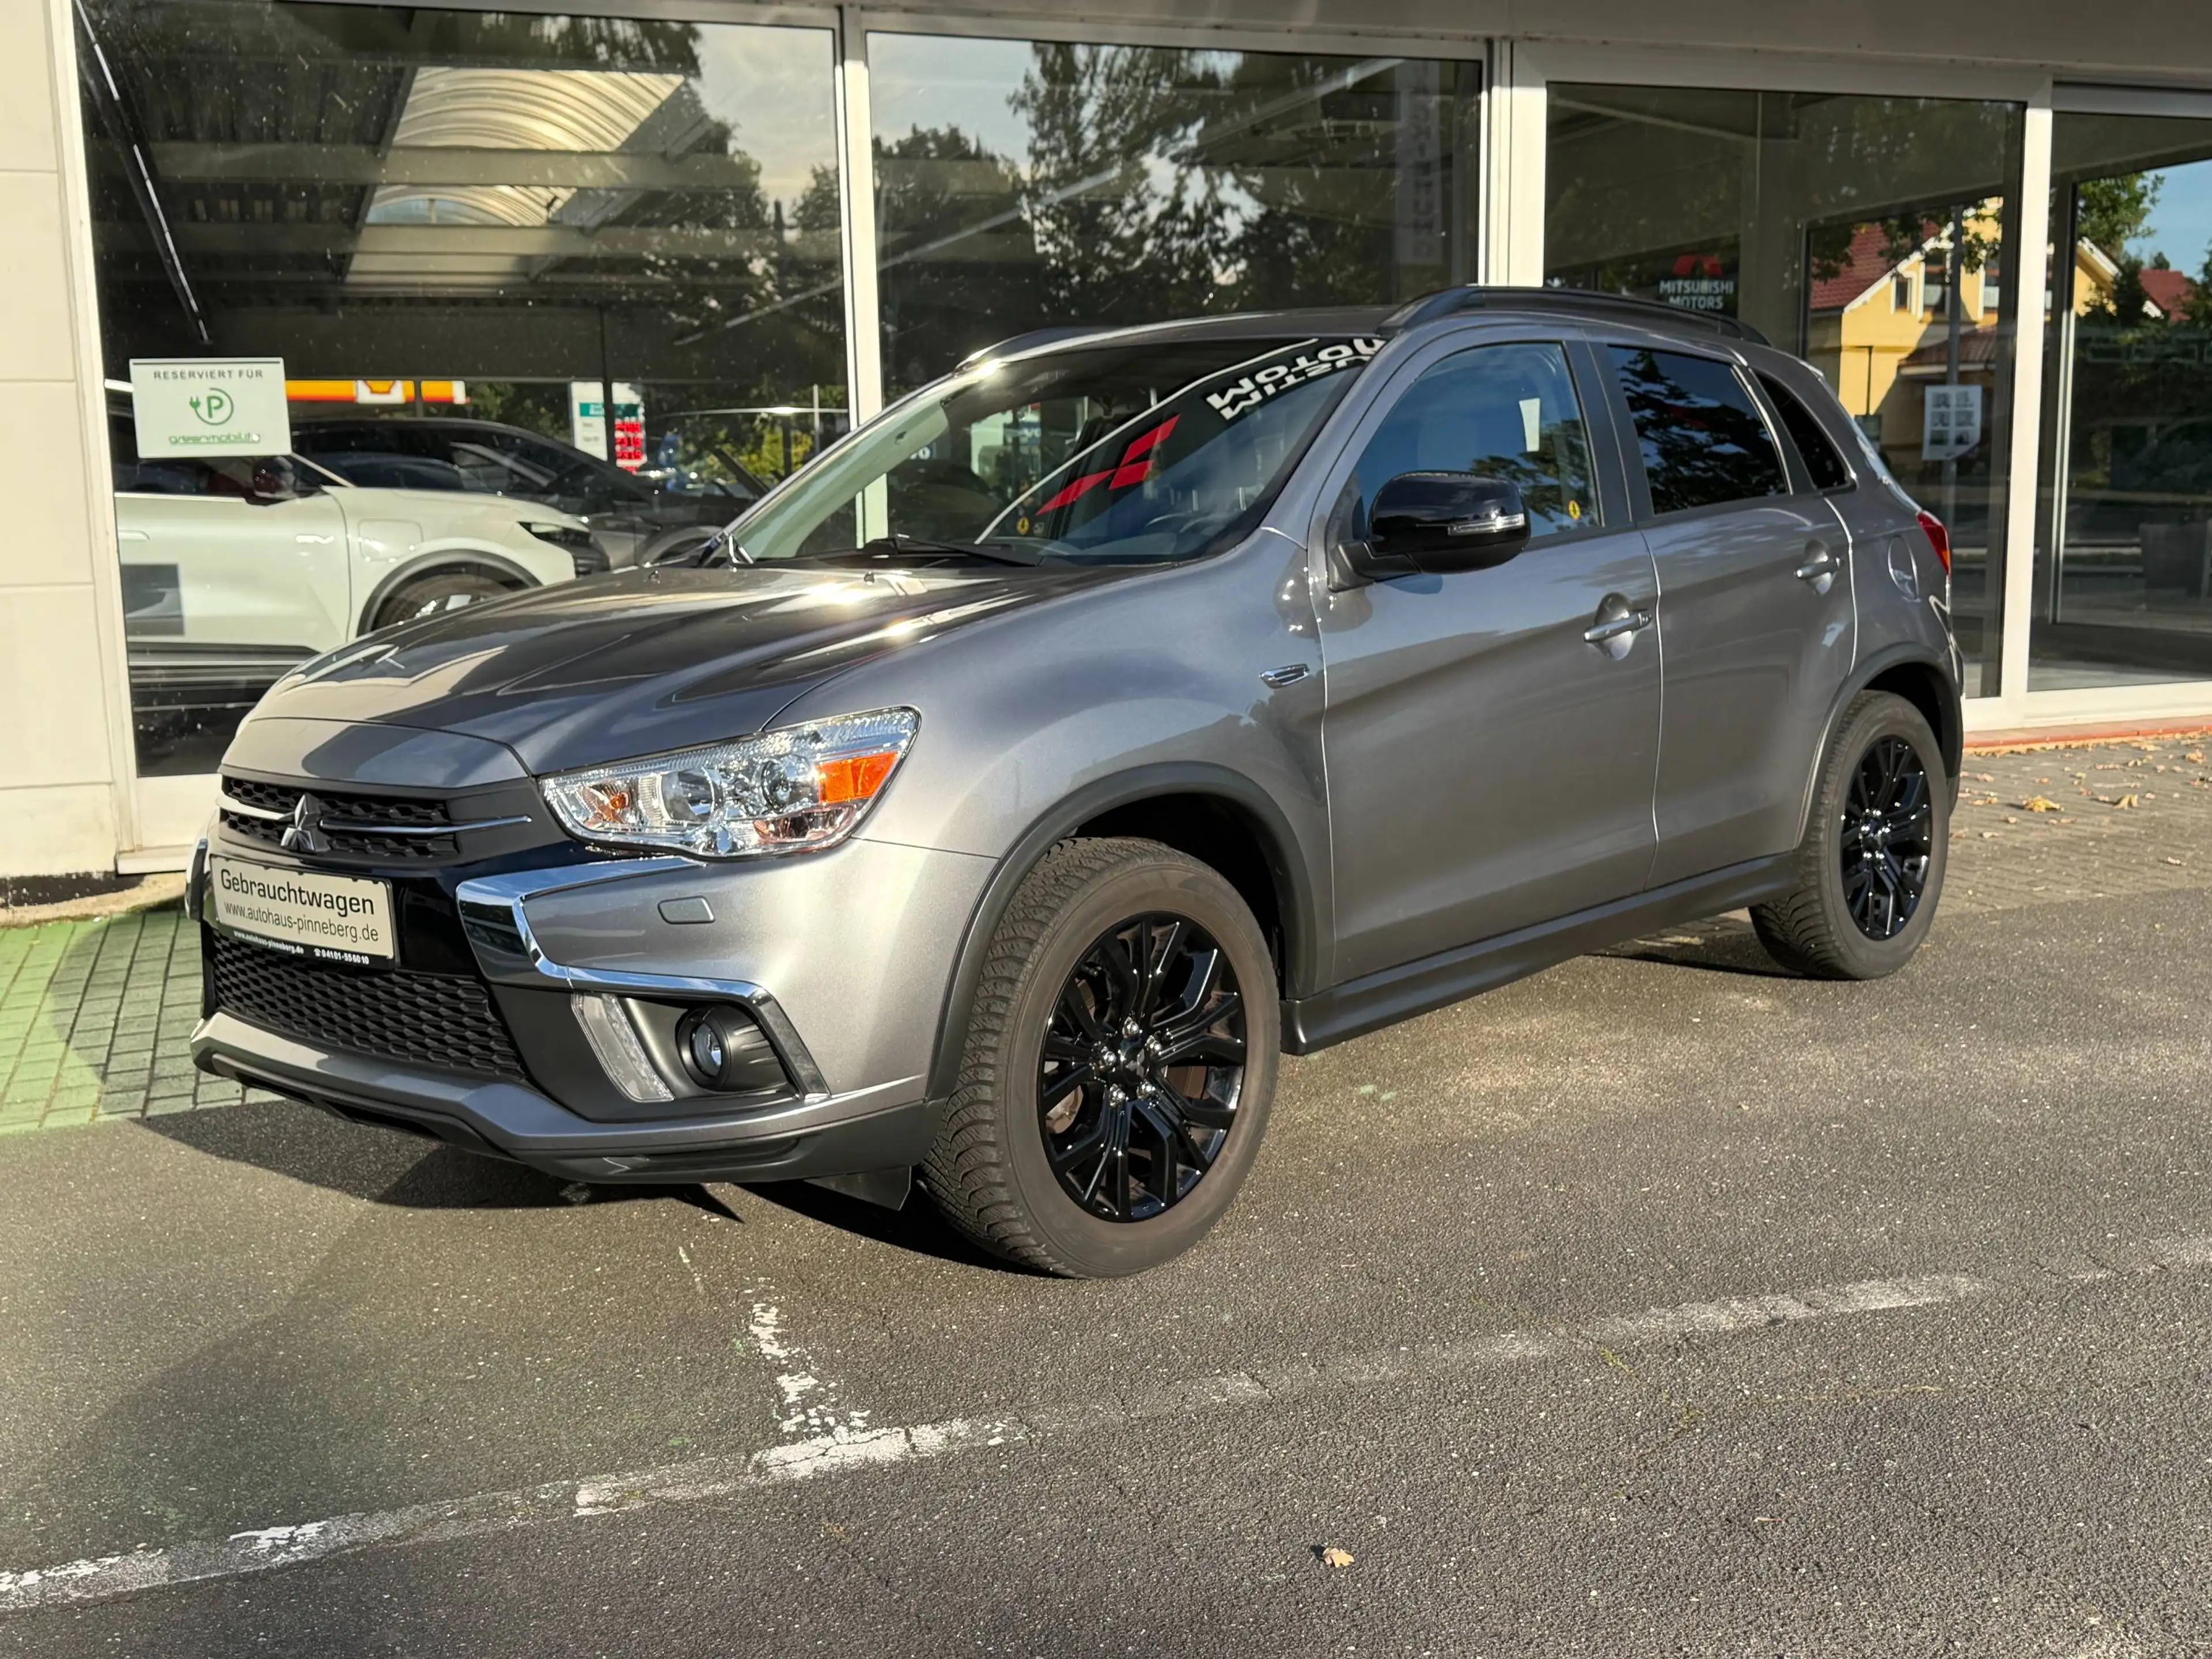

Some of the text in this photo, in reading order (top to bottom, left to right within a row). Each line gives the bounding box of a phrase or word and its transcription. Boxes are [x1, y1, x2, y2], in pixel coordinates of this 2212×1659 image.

[1660, 279, 1734, 294] MITSUBISHI
[1669, 296, 1724, 310] MOTORS
[153, 368, 263, 380] RESERVIERT FÜR
[221, 869, 375, 917] Gebrauchtwagen
[224, 902, 378, 944] www.autohaus-pinneberg.de
[233, 930, 305, 955] www.autohaus-pinneberg.de
